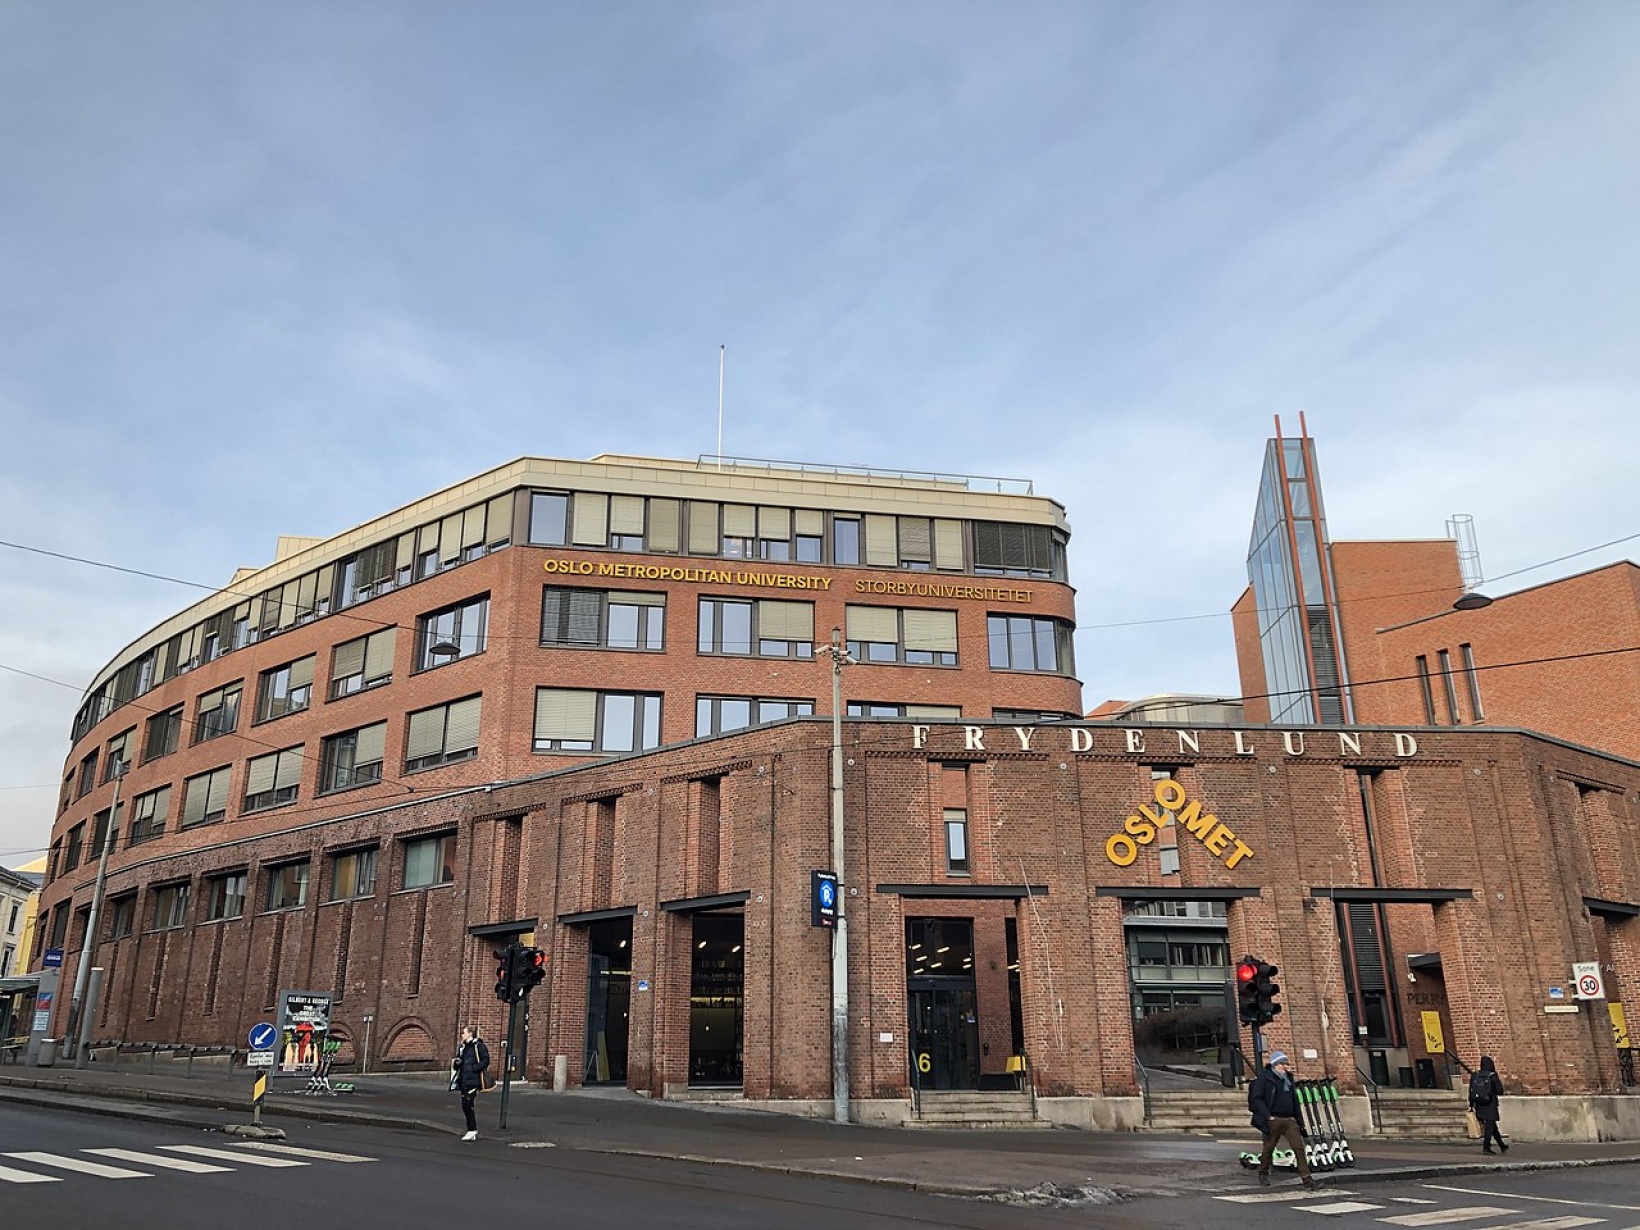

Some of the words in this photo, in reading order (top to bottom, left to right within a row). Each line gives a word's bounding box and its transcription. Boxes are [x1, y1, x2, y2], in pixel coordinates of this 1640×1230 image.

[543, 558, 594, 576] OSLO
[599, 562, 731, 584] METROPOLITAN
[737, 571, 832, 591] UNIVERSITY
[855, 578, 1033, 603] STORBYUNIVERSITETET
[911, 725, 1418, 757] FRYDENLUND
[1105, 779, 1254, 870] OSLOMET
[1583, 980, 1596, 990] 30
[918, 1053, 931, 1073] 6
